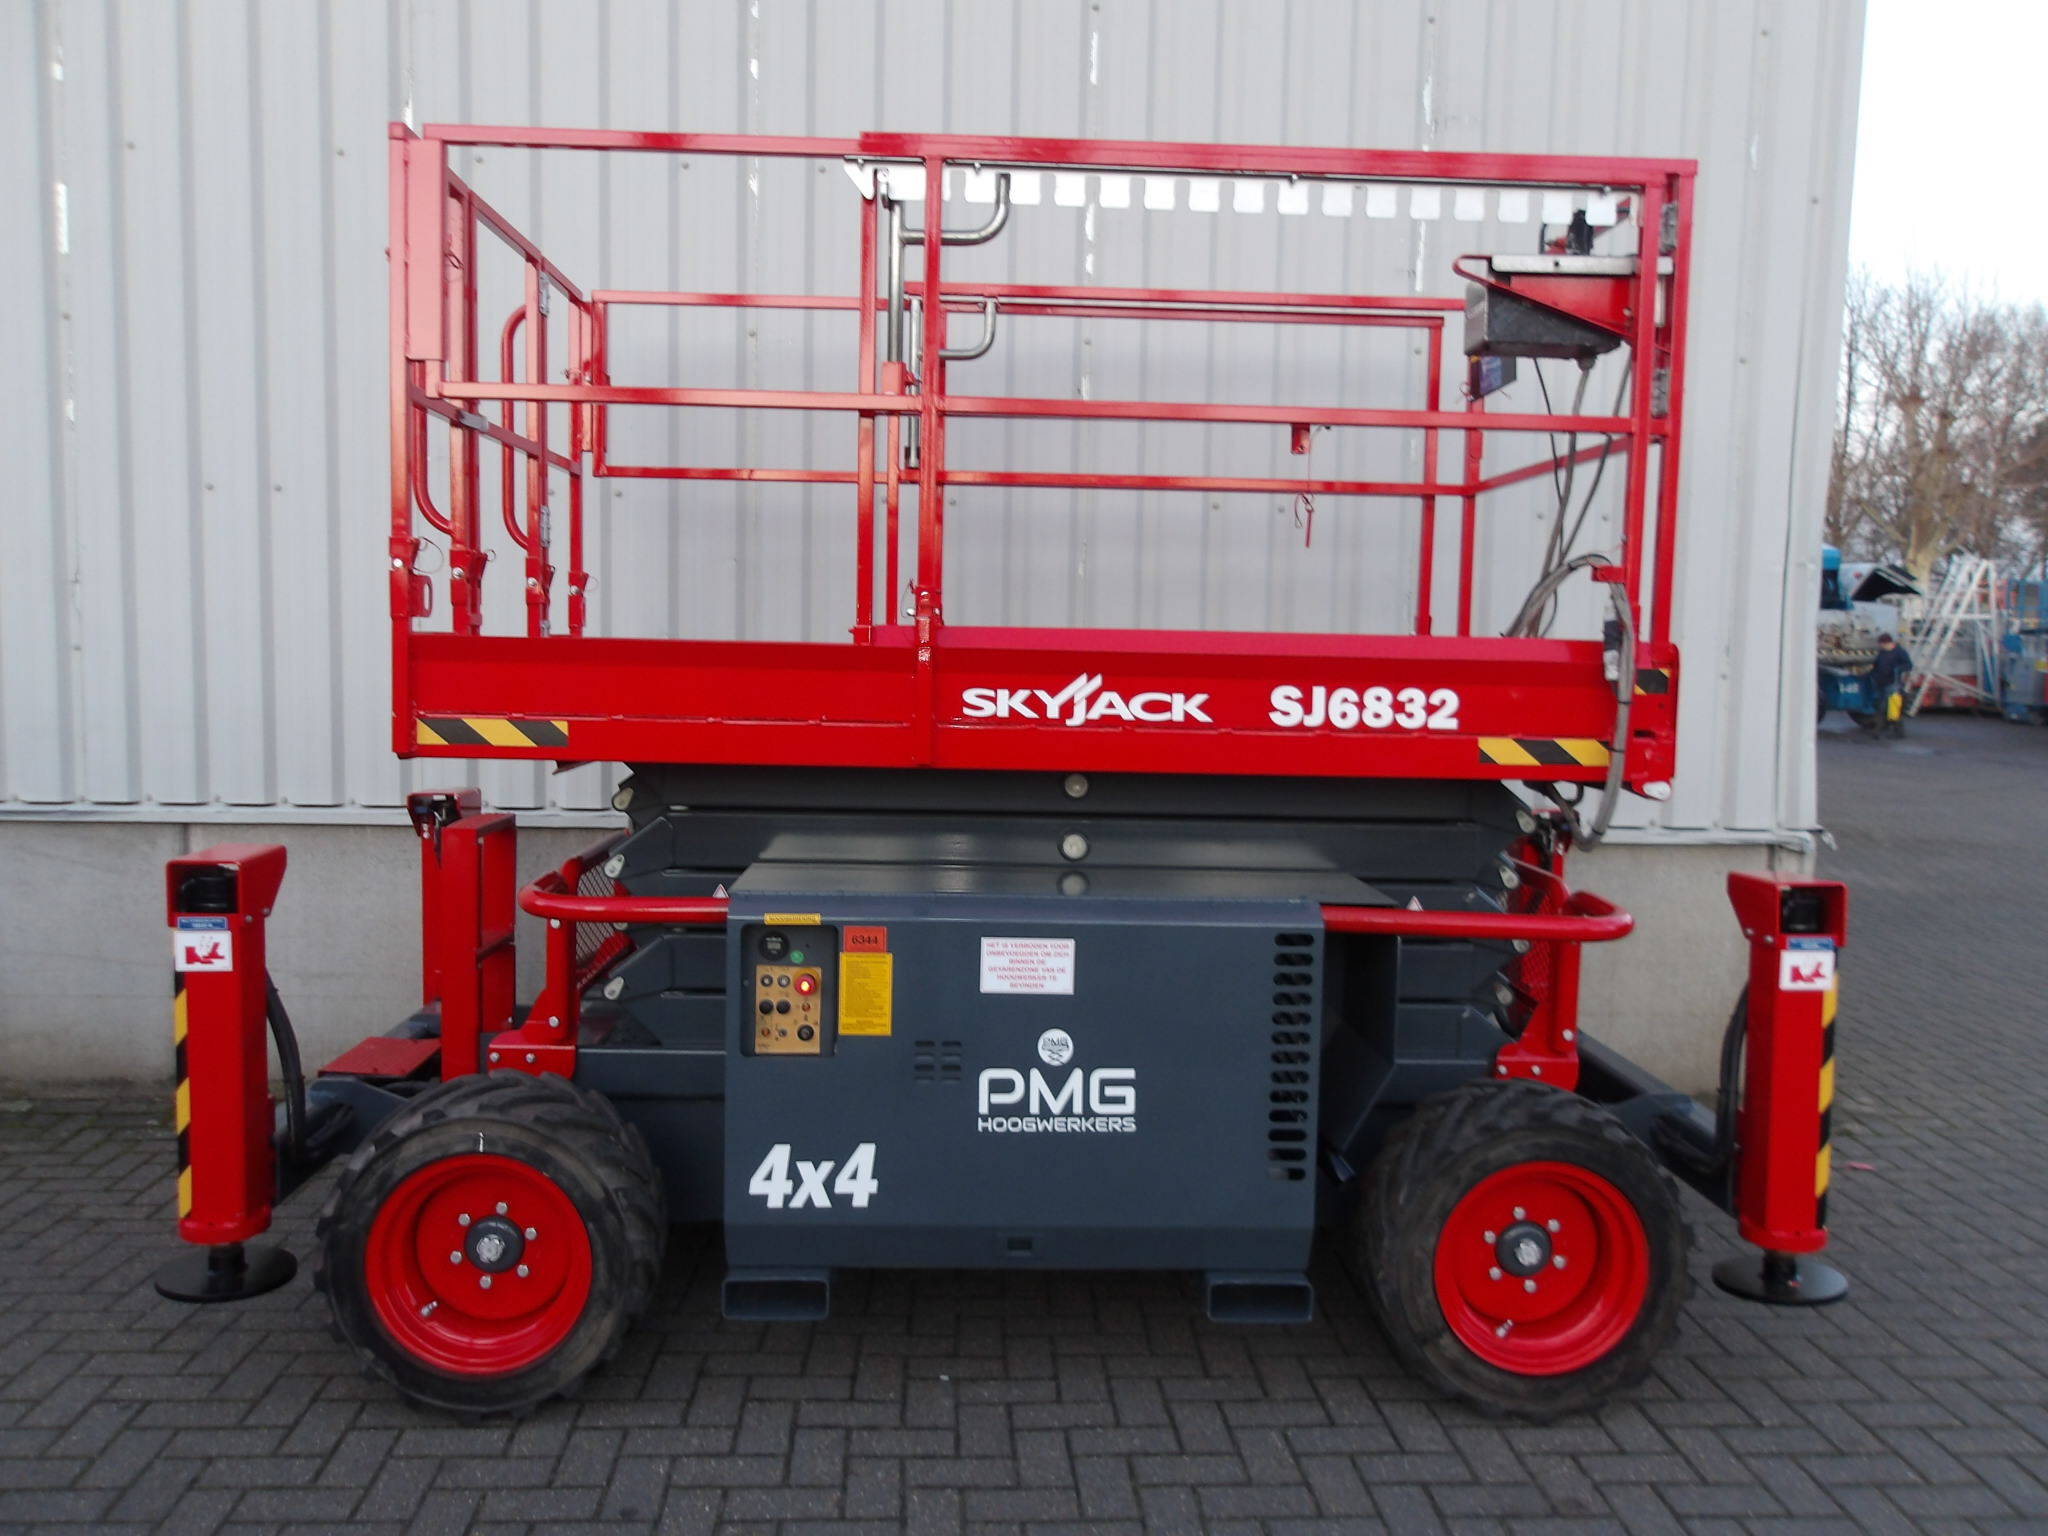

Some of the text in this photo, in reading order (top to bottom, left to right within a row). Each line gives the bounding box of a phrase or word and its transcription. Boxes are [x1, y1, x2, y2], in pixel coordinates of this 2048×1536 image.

[961, 672, 1459, 730] SKYJACK SJ6832
[852, 935, 878, 945] 6344
[979, 1067, 1136, 1115] PMG
[978, 1117, 1137, 1132] HOOGWERKERS
[748, 1143, 879, 1208] 4x4
